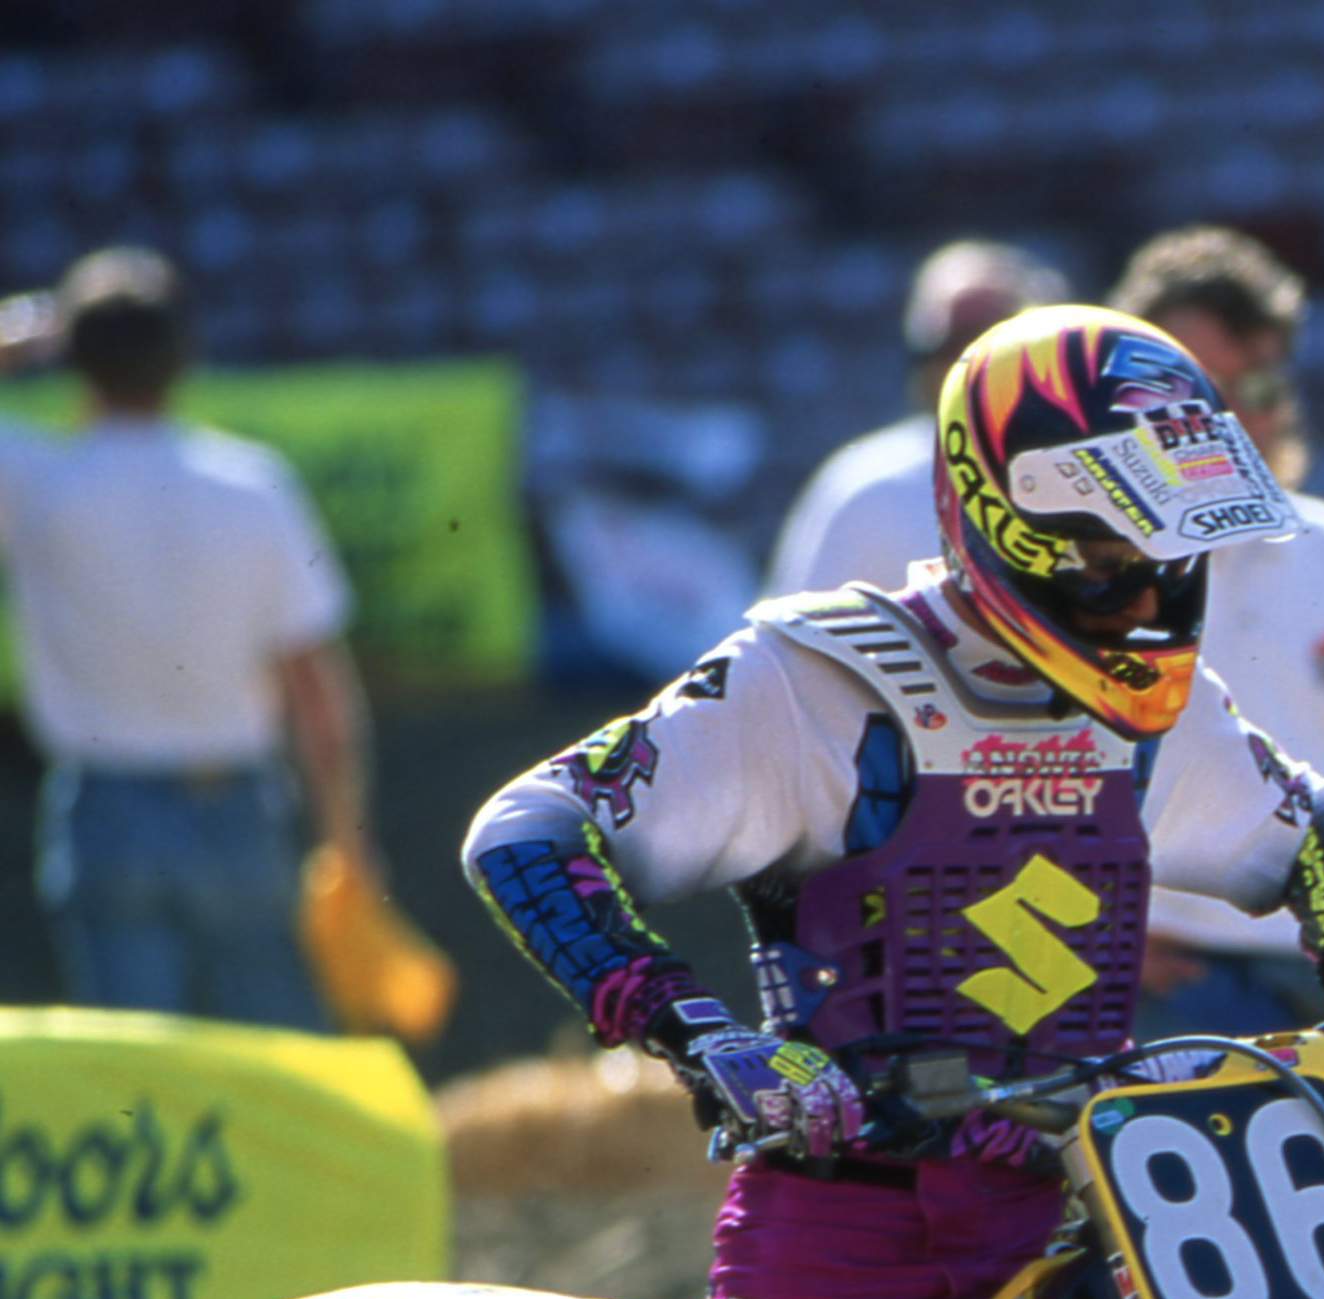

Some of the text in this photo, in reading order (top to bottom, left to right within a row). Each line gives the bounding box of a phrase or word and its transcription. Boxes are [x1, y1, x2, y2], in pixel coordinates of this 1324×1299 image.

[1112, 438, 1177, 507] Suzuki
[1192, 502, 1275, 535] SHOEI
[964, 779, 1104, 817] OAKLEY
[0, 1095, 242, 1228] oors
